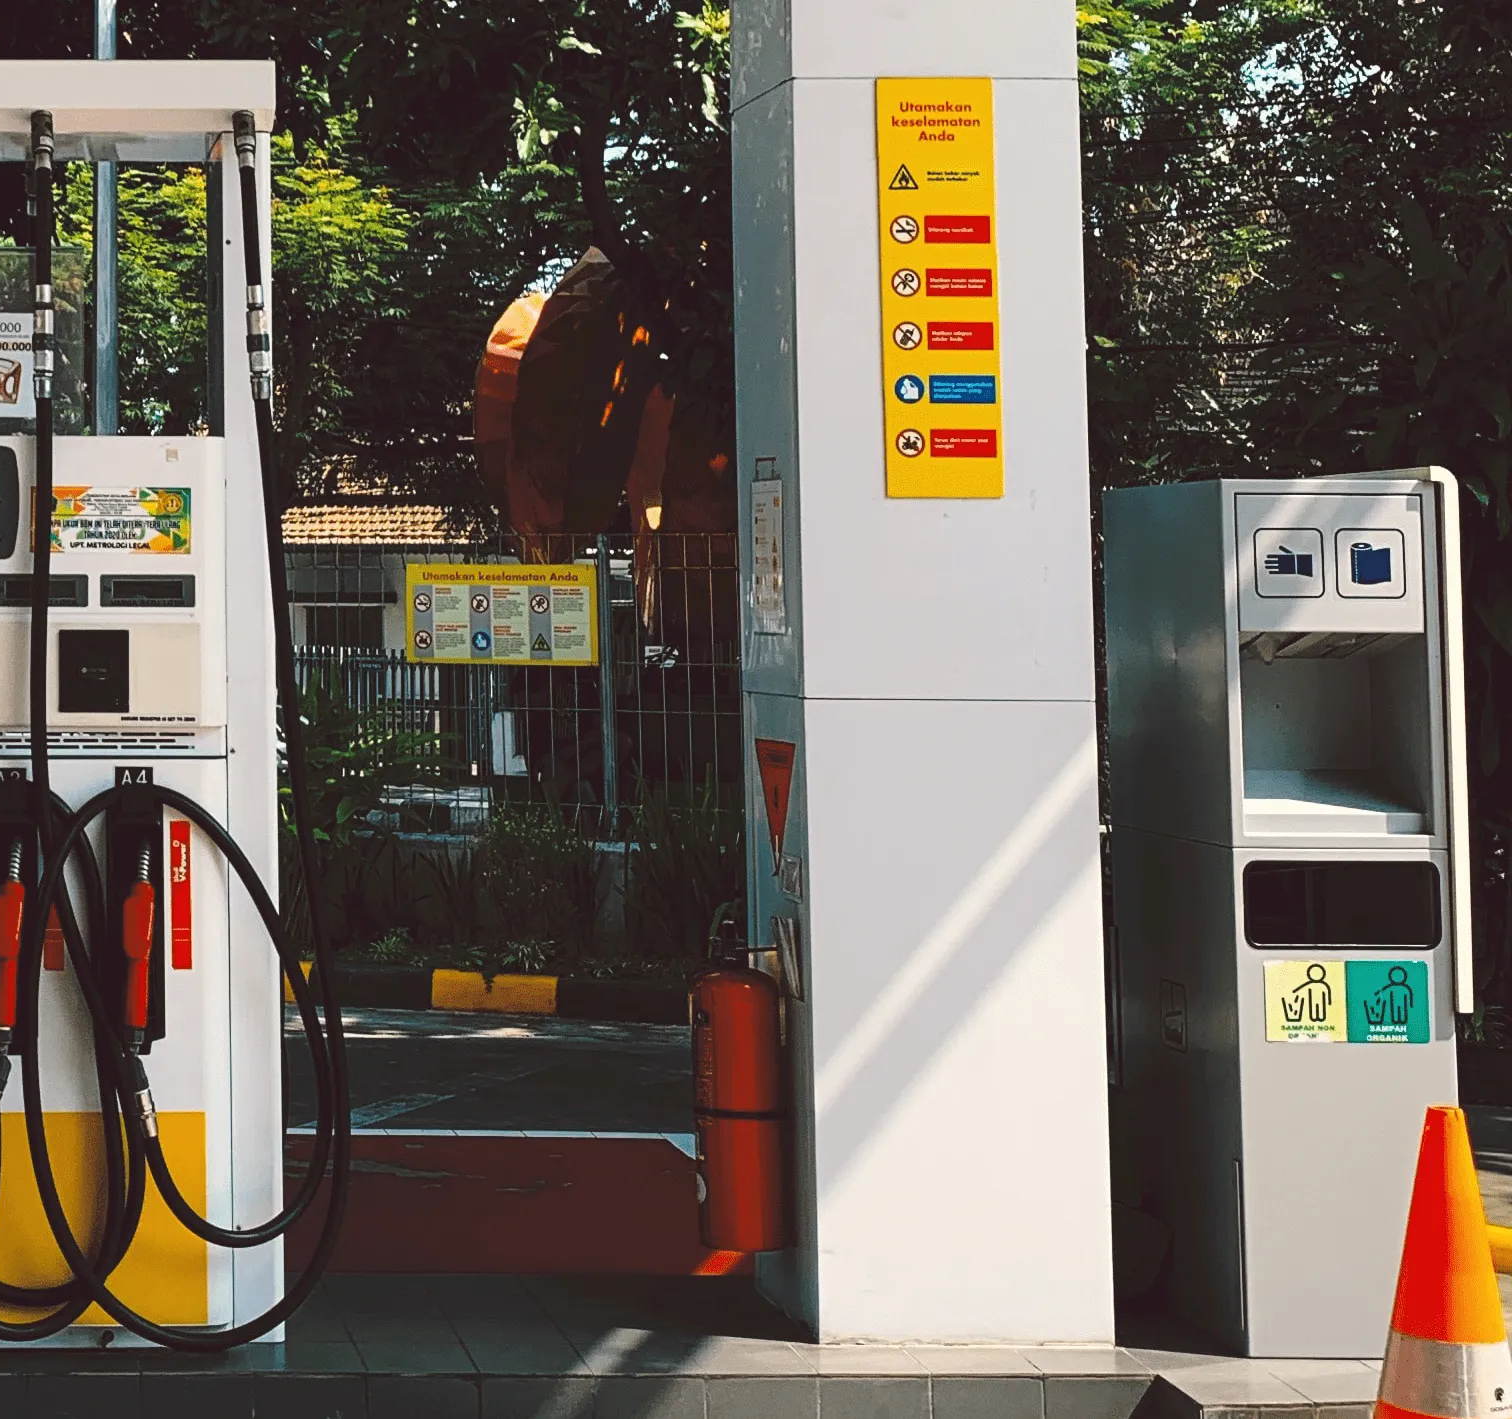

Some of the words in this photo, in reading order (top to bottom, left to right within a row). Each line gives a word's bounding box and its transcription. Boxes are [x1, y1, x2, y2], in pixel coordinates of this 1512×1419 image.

[900, 101, 971, 112] Utamakan
[892, 116, 980, 127] keselamatan
[919, 130, 955, 141] Anda
[422, 572, 475, 581] Utamakan
[478, 572, 546, 581] keselamatan
[549, 572, 578, 581] Anda
